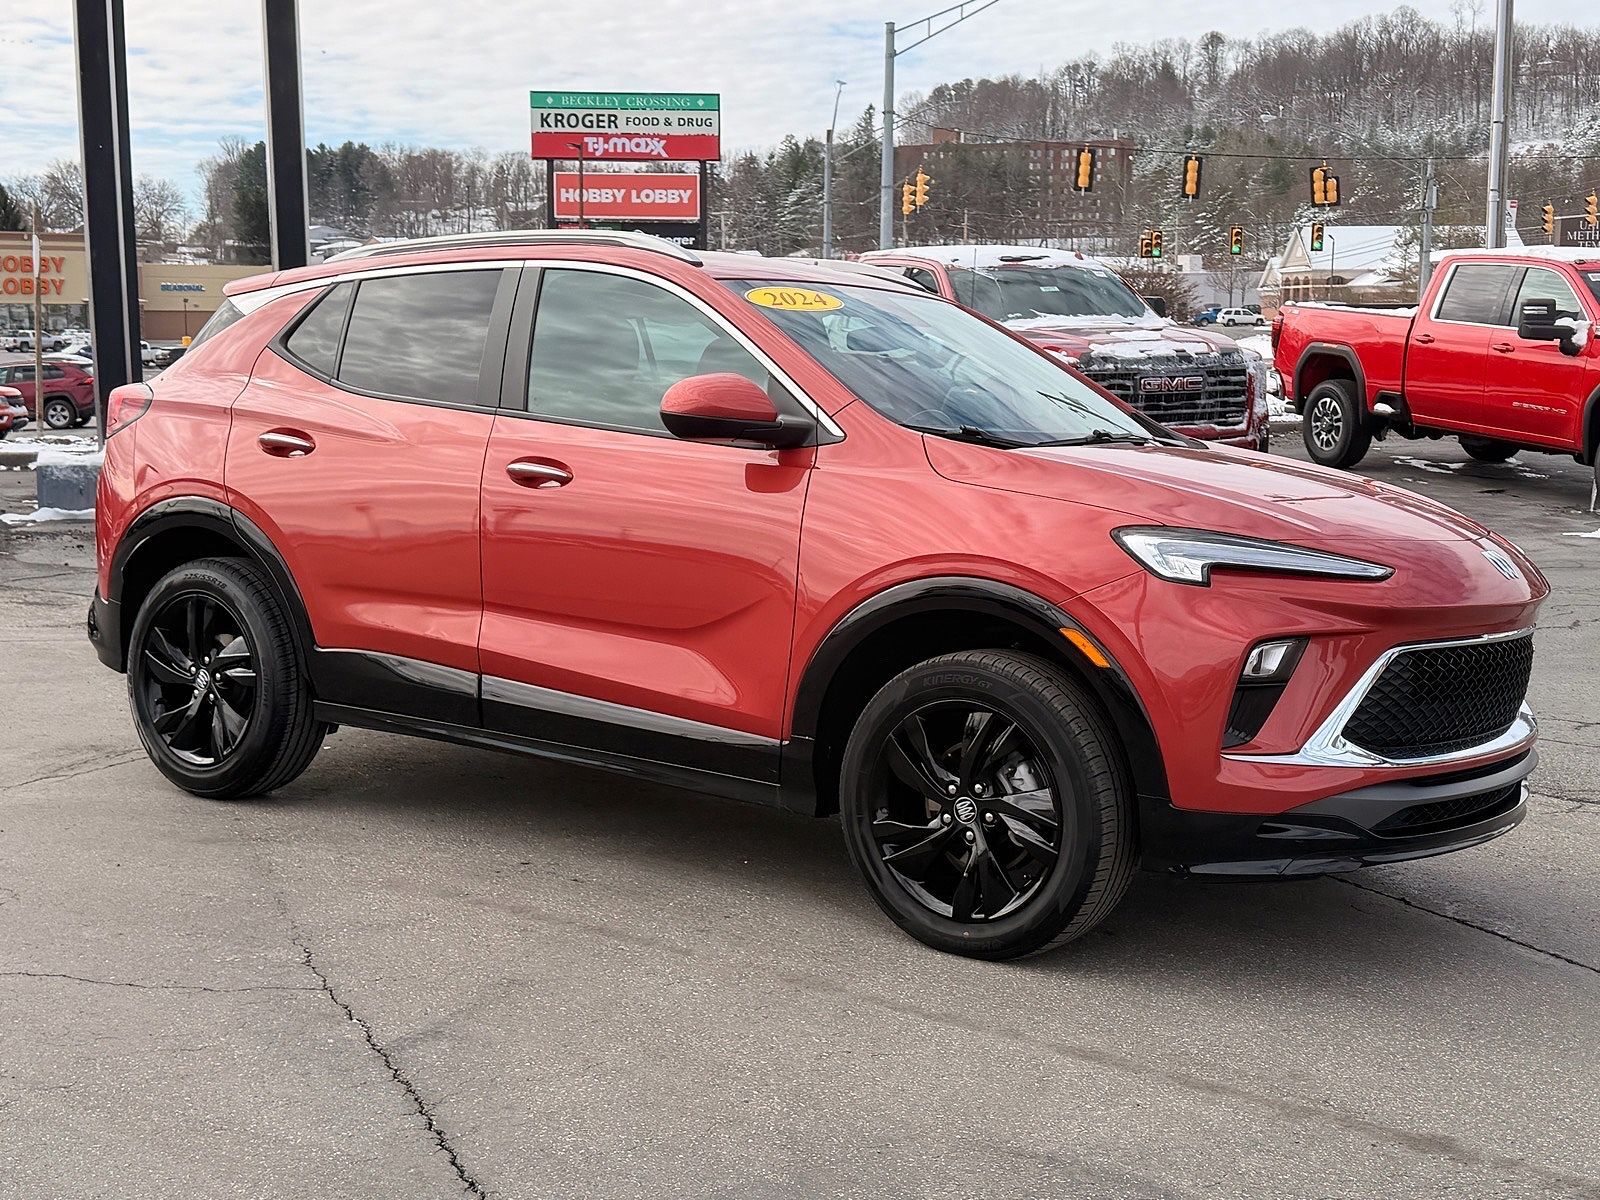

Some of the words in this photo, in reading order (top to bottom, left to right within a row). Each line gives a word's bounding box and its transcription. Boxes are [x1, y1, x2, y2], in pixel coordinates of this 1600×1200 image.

[561, 96, 620, 106] BECKLEY
[626, 97, 691, 107] CROSSING
[540, 113, 619, 129] KROGER
[625, 116, 660, 127] FOOD
[663, 117, 673, 127] &
[677, 117, 713, 128] DRUG
[560, 188, 626, 203] HOBBY
[631, 189, 693, 203] LOBBY
[0, 255, 65, 273] OBBY
[0, 278, 65, 295] OBBY
[763, 292, 828, 306] 2024
[1141, 377, 1203, 392] GMC
